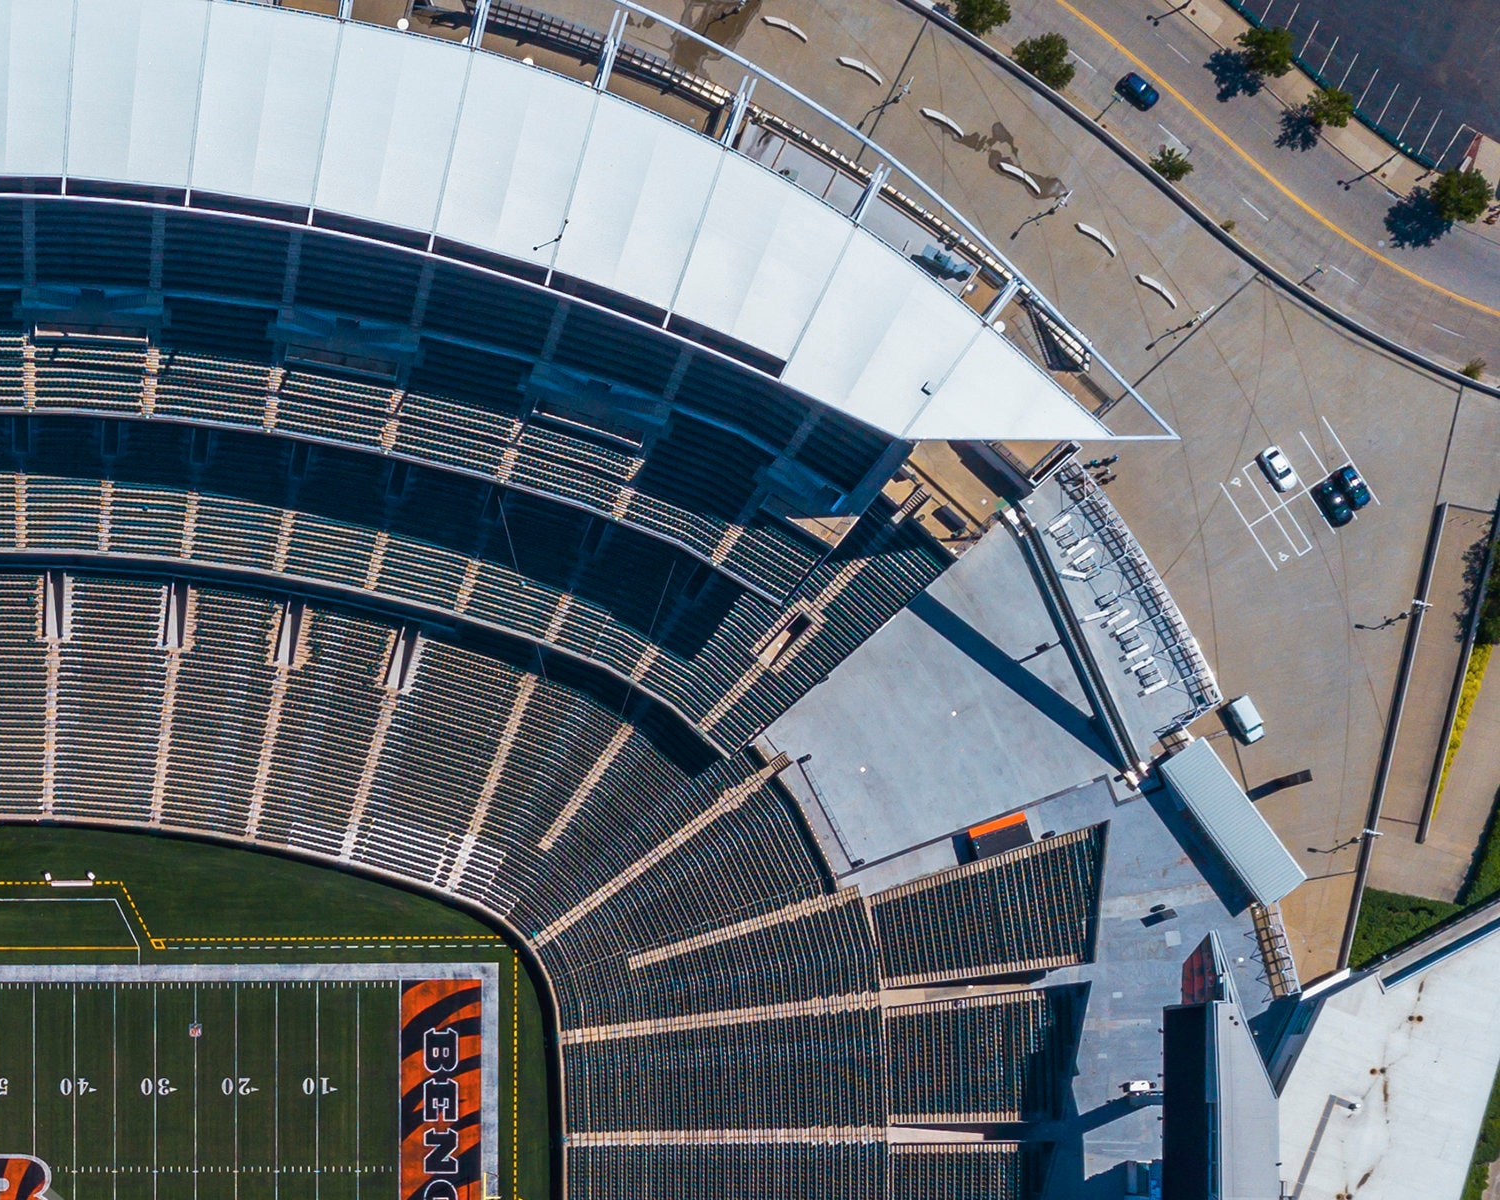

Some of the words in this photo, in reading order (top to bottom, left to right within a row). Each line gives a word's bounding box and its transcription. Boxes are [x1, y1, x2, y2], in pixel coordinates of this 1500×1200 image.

[60, 1077, 89, 1096] 40
[140, 1077, 170, 1096] 30
[221, 1077, 251, 1096] 20
[302, 1077, 330, 1096] 10
